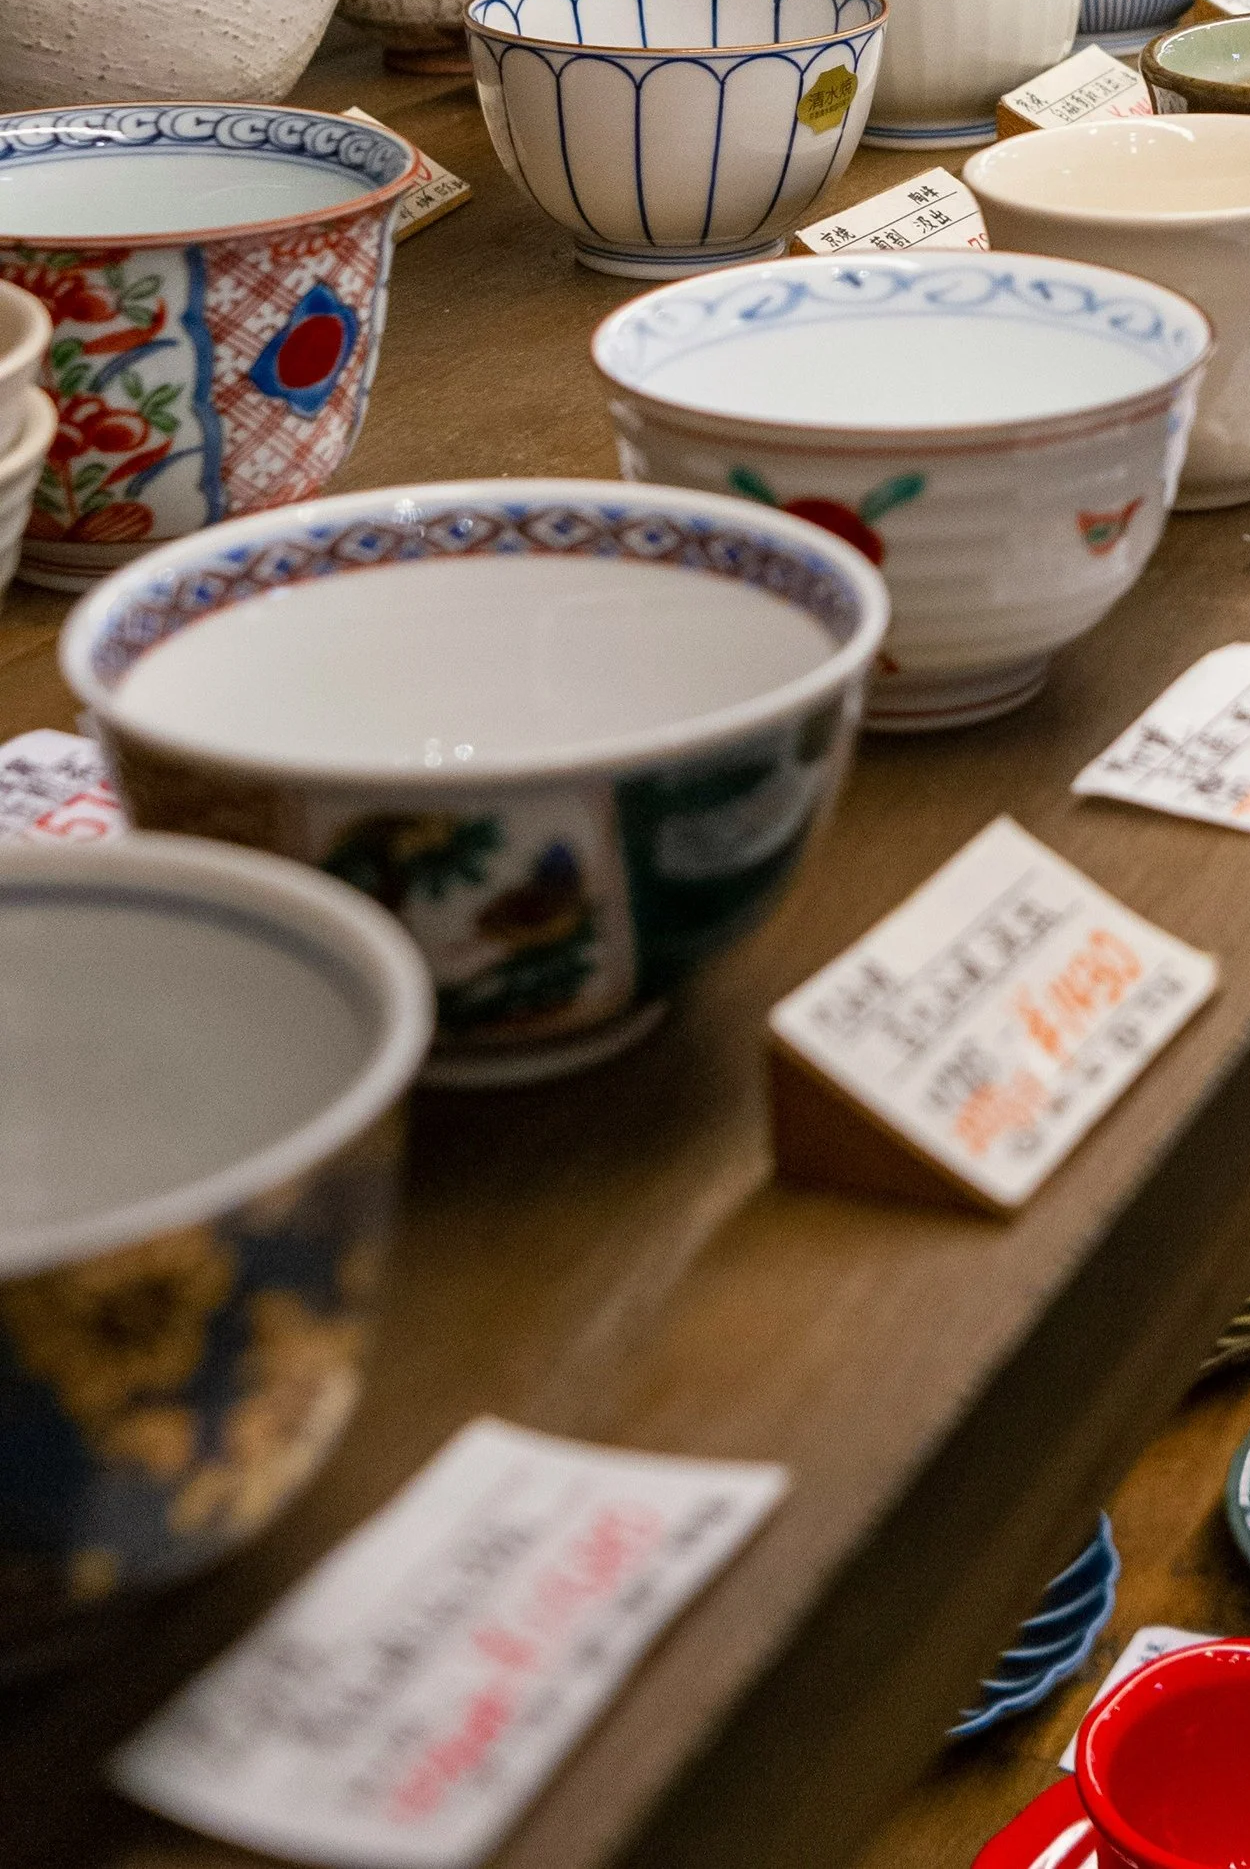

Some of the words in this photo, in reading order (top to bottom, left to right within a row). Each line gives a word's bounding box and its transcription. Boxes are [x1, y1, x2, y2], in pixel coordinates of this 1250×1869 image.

[808, 76, 854, 112] 清水焼
[912, 208, 954, 235] 汲出
[820, 224, 857, 248] 京焼
